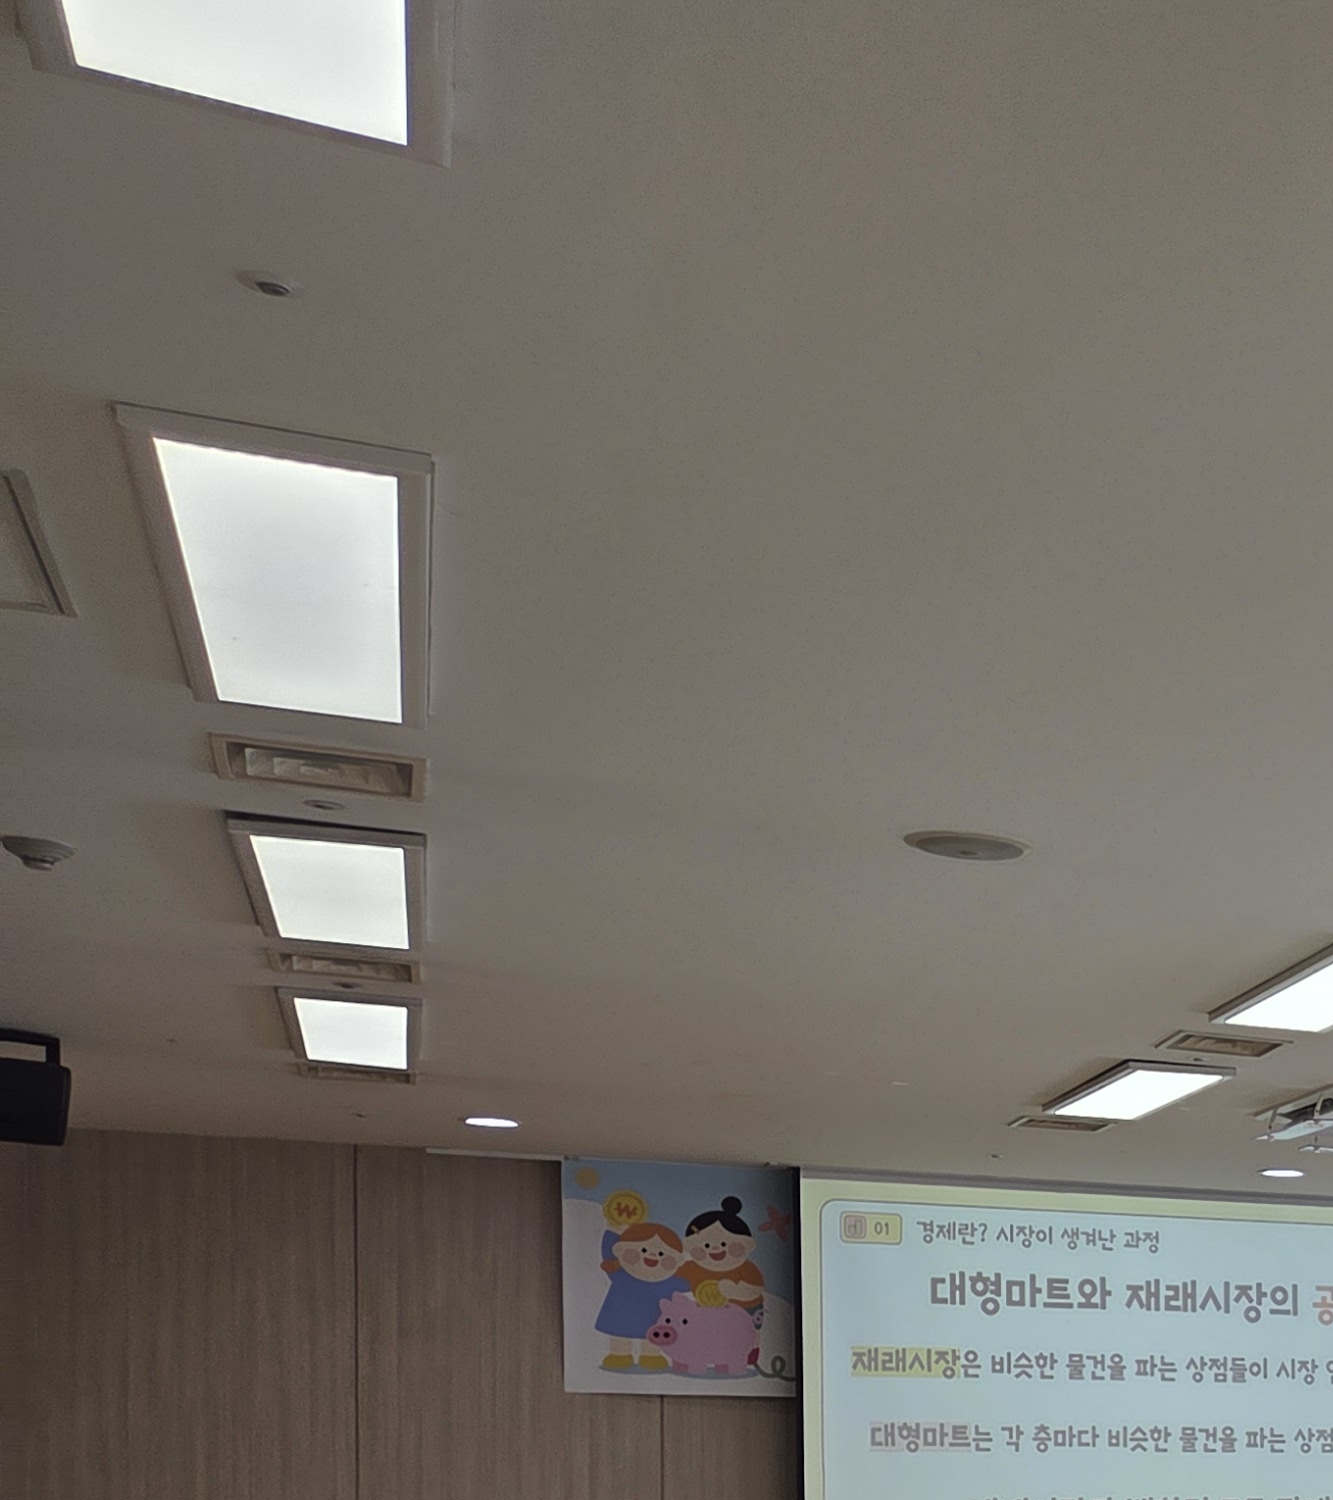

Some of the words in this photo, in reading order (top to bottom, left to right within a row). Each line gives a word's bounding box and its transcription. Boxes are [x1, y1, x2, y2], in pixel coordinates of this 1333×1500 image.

[873, 1221, 890, 1236] 01
[916, 1219, 988, 1245] 경제란?
[995, 1223, 1053, 1249] 시장이
[1060, 1226, 1117, 1252] 생겨난
[1123, 1229, 1160, 1254] 과정
[929, 1270, 1113, 1317] 대형마트와
[1124, 1277, 1299, 1324] 재래시장의
[851, 1347, 982, 1381] 재래시장은
[990, 1351, 1059, 1381] 비슷한
[1065, 1352, 1127, 1382] 물건을
[1134, 1354, 1178, 1382] 파는
[1185, 1356, 1268, 1384] 상점들이
[1275, 1358, 1319, 1386] 시장
[869, 1421, 994, 1454] 대형마트는
[1000, 1424, 1025, 1453] 각
[1031, 1423, 1100, 1454] 층마다
[1107, 1424, 1172, 1454] 비슷한
[1178, 1425, 1238, 1454] 물건을
[1245, 1426, 1287, 1454] 파는
